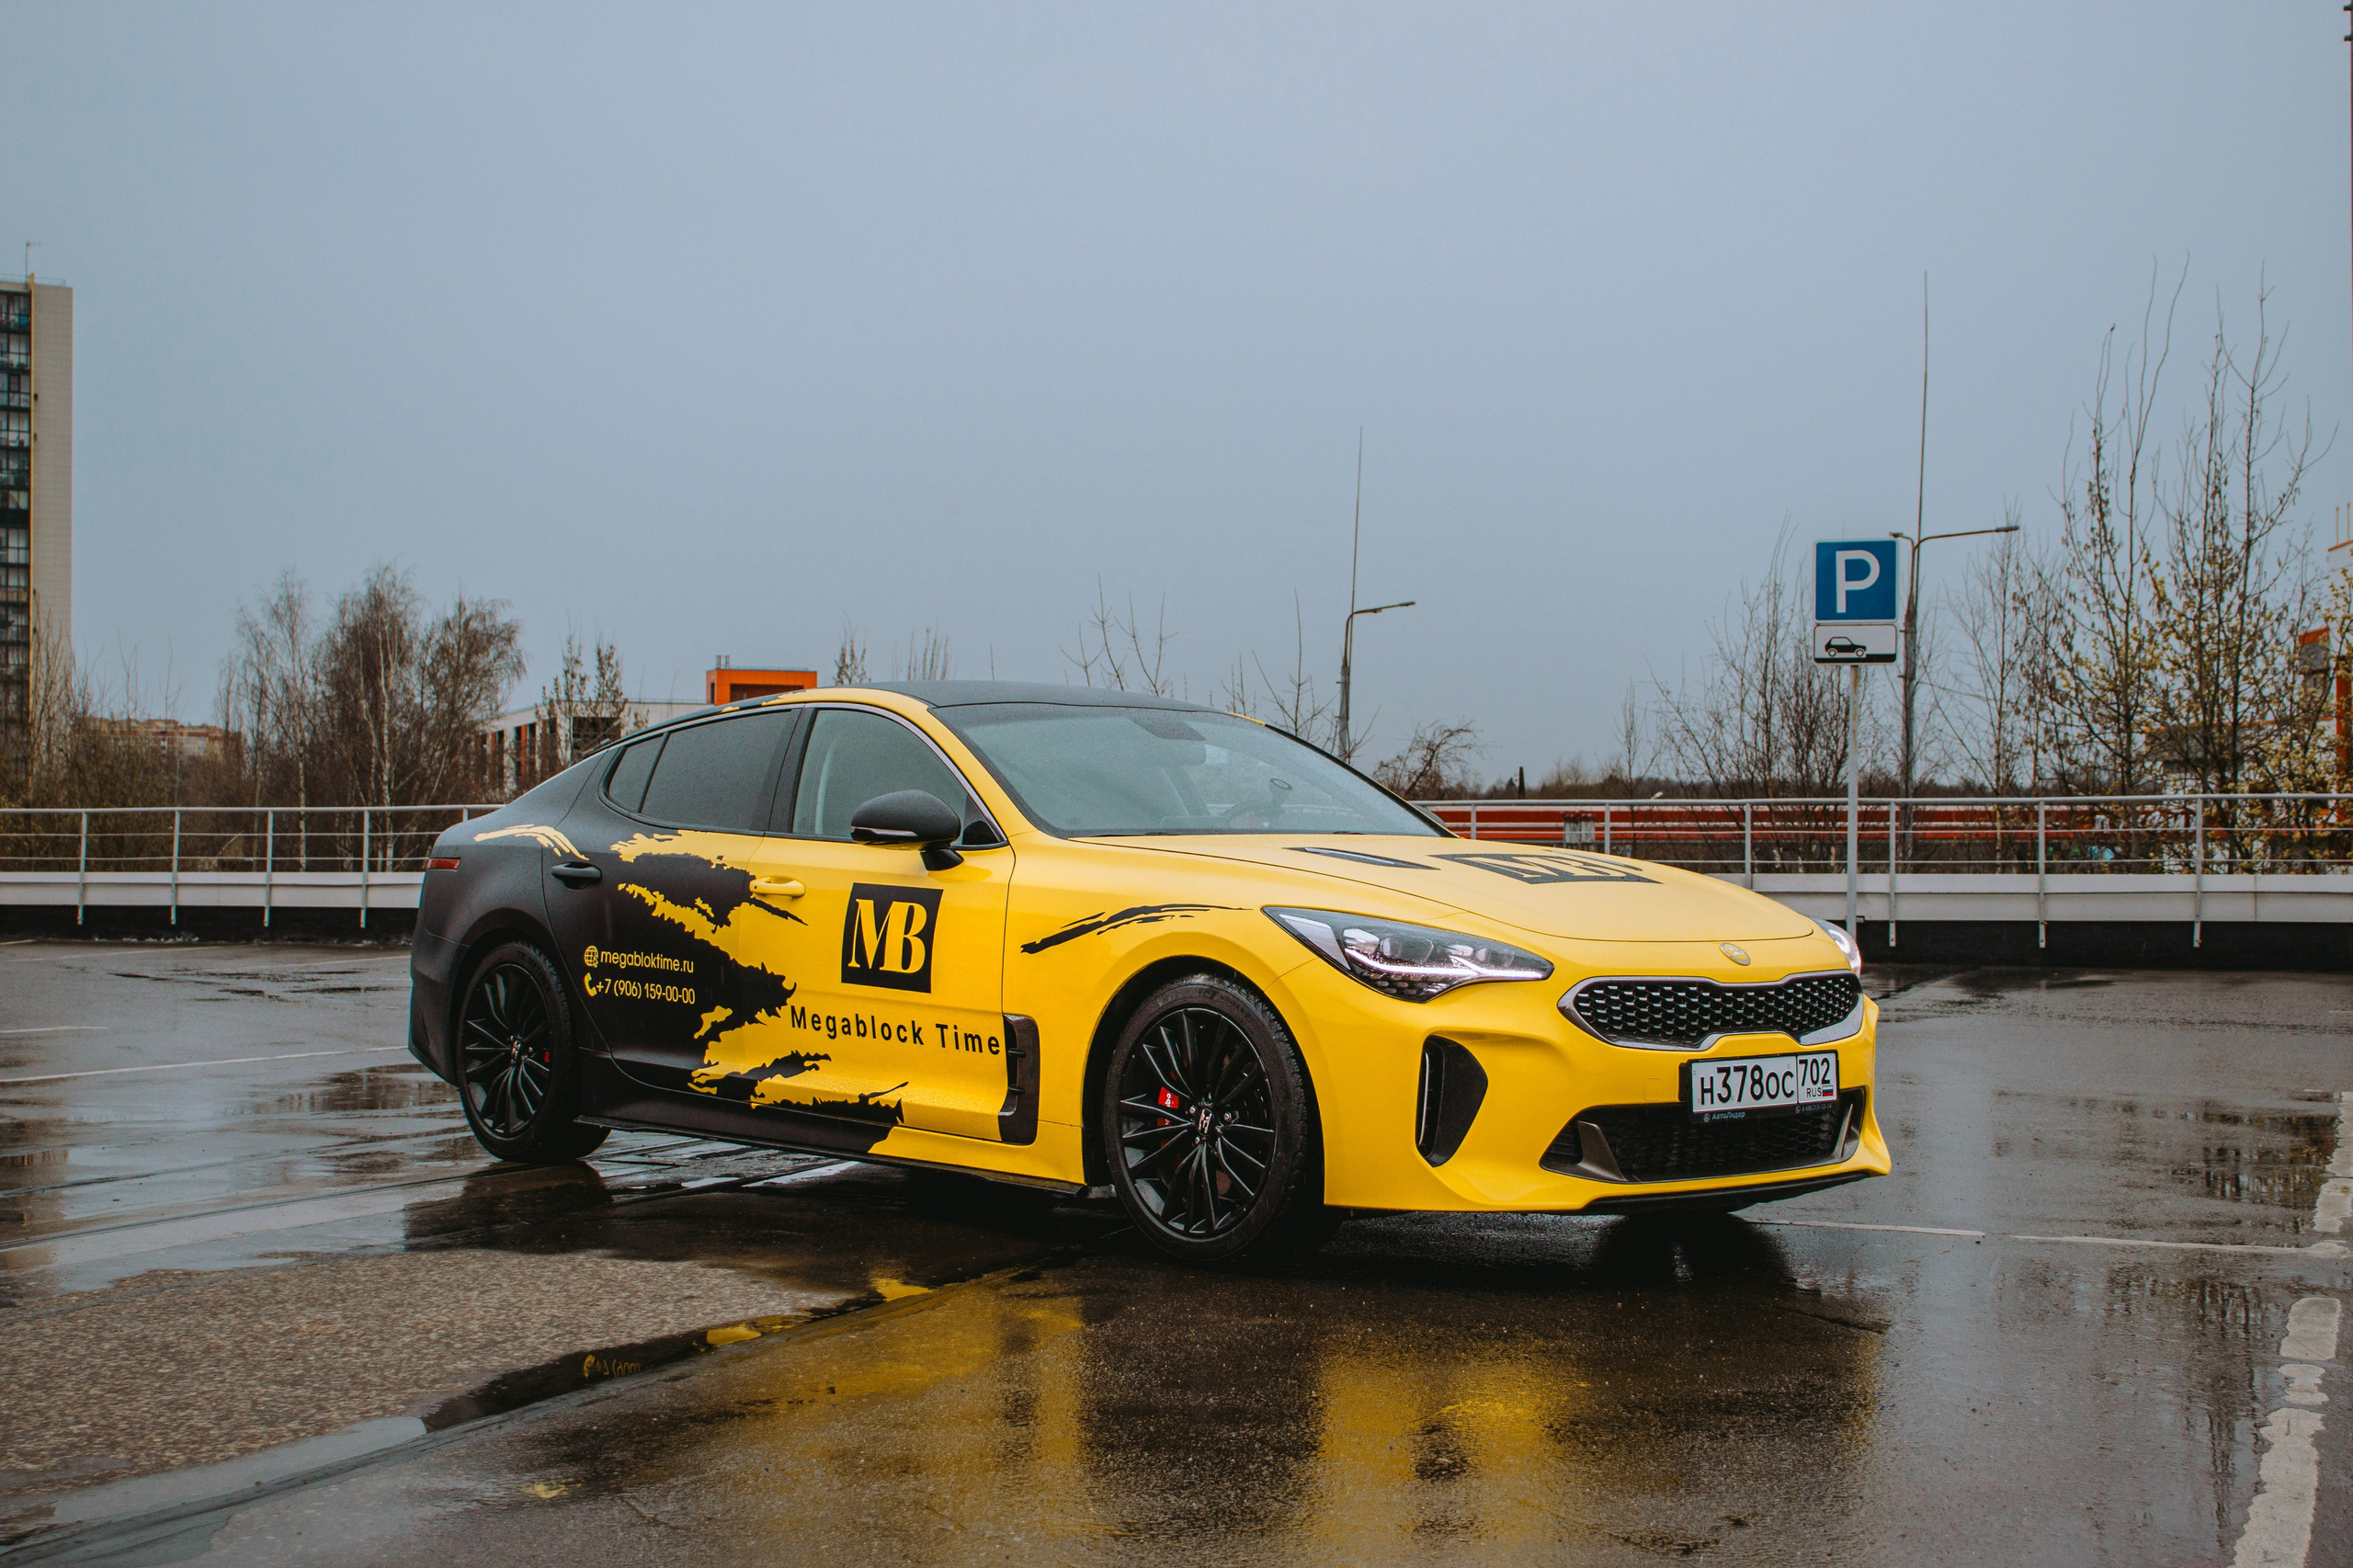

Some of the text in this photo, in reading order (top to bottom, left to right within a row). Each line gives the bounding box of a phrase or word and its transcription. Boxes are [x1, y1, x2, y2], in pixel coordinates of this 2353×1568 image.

[1836, 549, 1881, 614] P
[847, 898, 927, 974] MB
[600, 950, 694, 973] megabloktime.ru
[596, 978, 696, 1005] +7 (906) 159-00-00
[790, 1005, 1001, 1056] Megablock Time
[1798, 1057, 1831, 1086] 702
[1806, 1086, 1822, 1097] RUS
